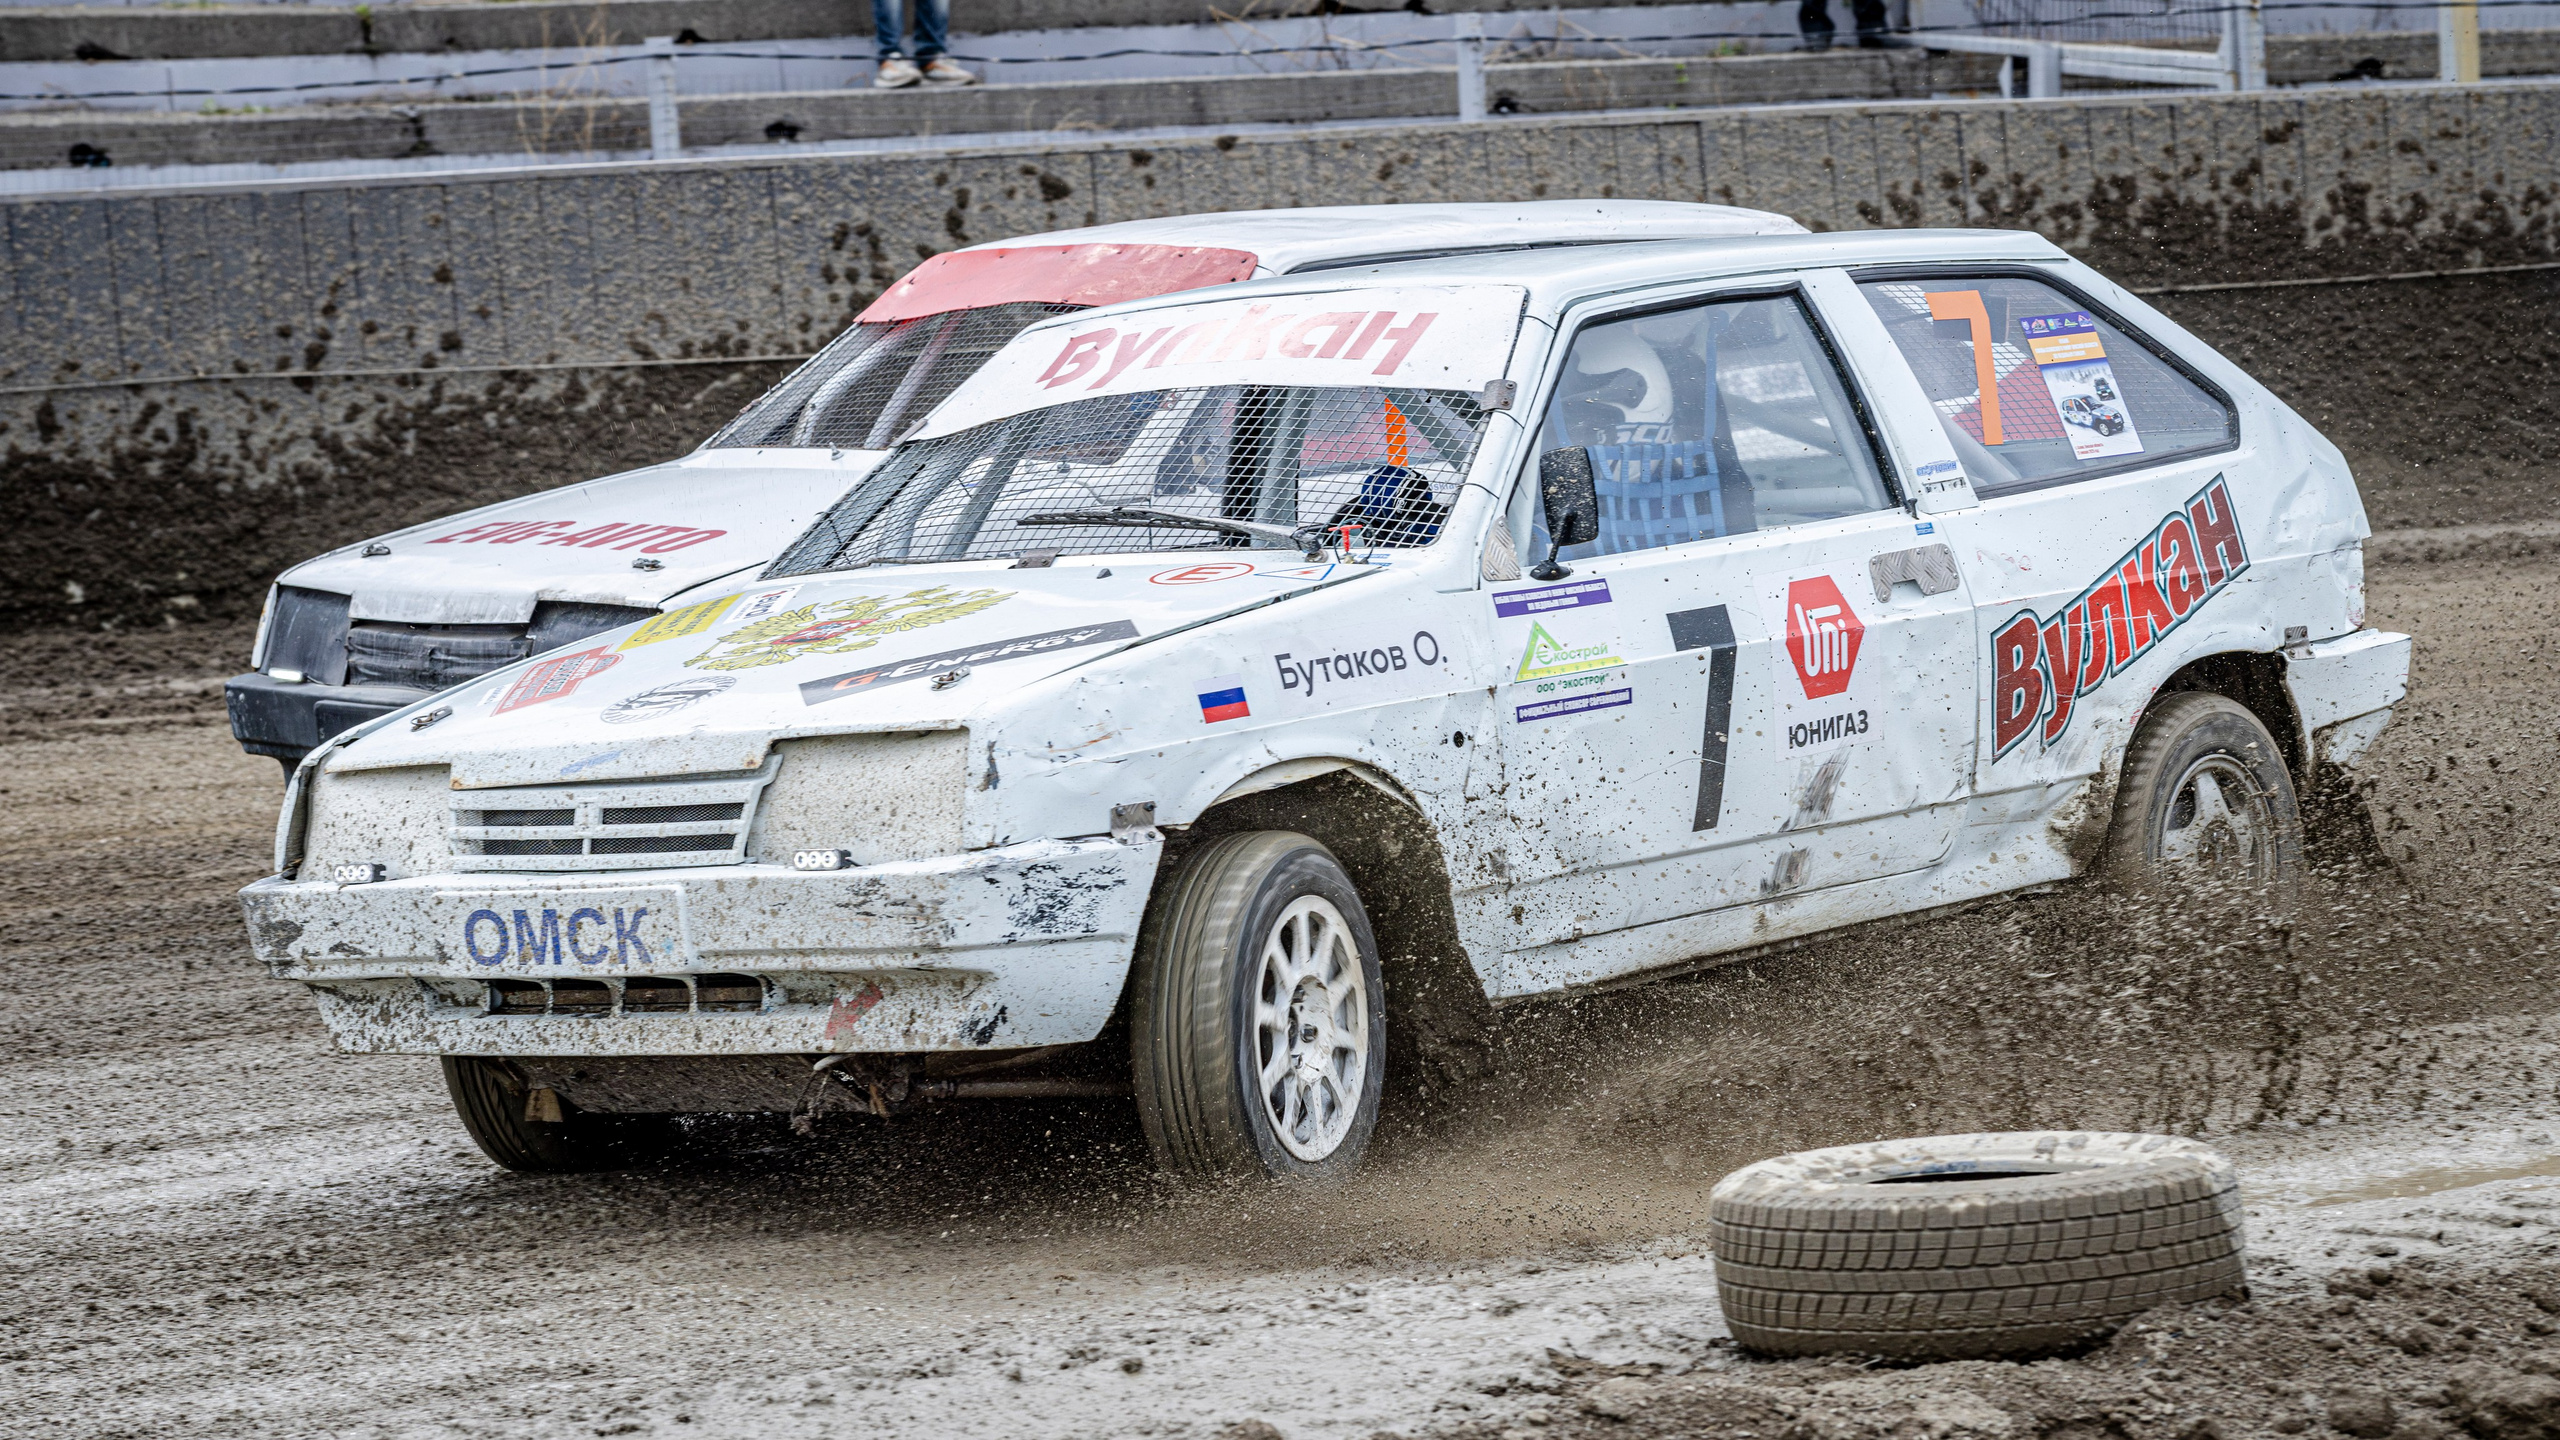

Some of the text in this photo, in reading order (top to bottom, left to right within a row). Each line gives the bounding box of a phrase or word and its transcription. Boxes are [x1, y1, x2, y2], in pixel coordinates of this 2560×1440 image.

[1924, 290, 2003, 445] 7
[425, 520, 727, 554] EVG-AVTO
[1990, 472, 2251, 765] Вулкан
[1274, 630, 1448, 697] Бутаков О.
[1536, 682, 1556, 694] ООО
[1666, 604, 1737, 832] 7
[1788, 709, 1869, 750] ЮНИГАЗ
[464, 907, 652, 966] ОМСК
